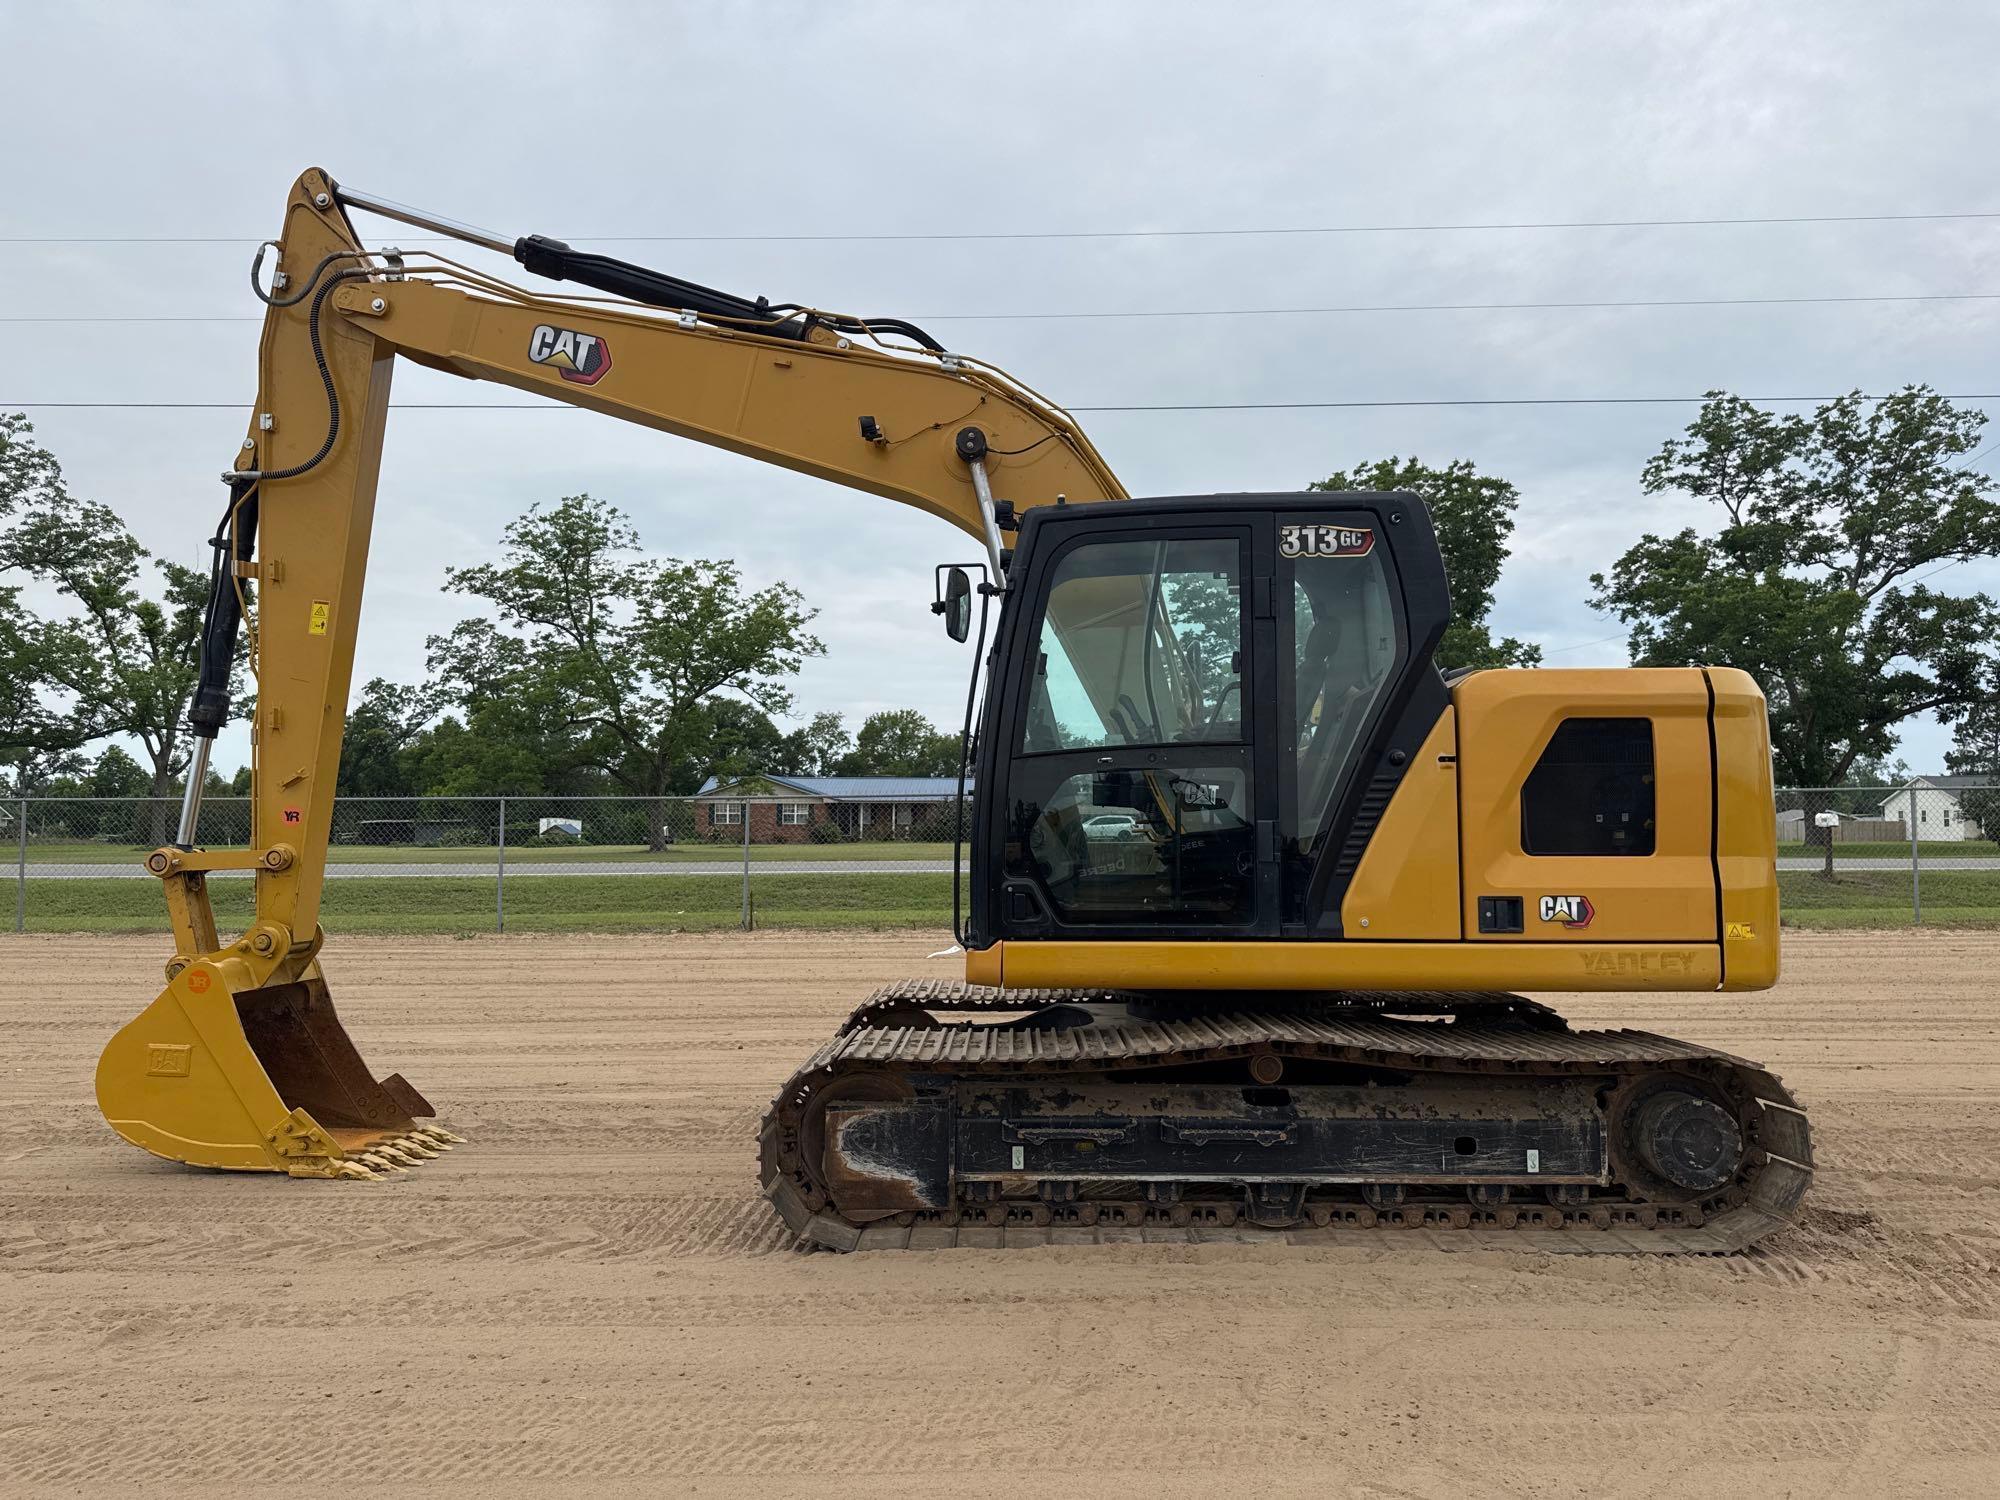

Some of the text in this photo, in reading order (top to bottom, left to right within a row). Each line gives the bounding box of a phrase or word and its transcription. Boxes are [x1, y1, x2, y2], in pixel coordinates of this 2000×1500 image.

[530, 325, 596, 371] CAT
[1281, 527, 1361, 554] 313 GC
[284, 810, 300, 822] YR
[1540, 896, 1581, 921] CAT
[1578, 950, 1697, 976] YANCEY
